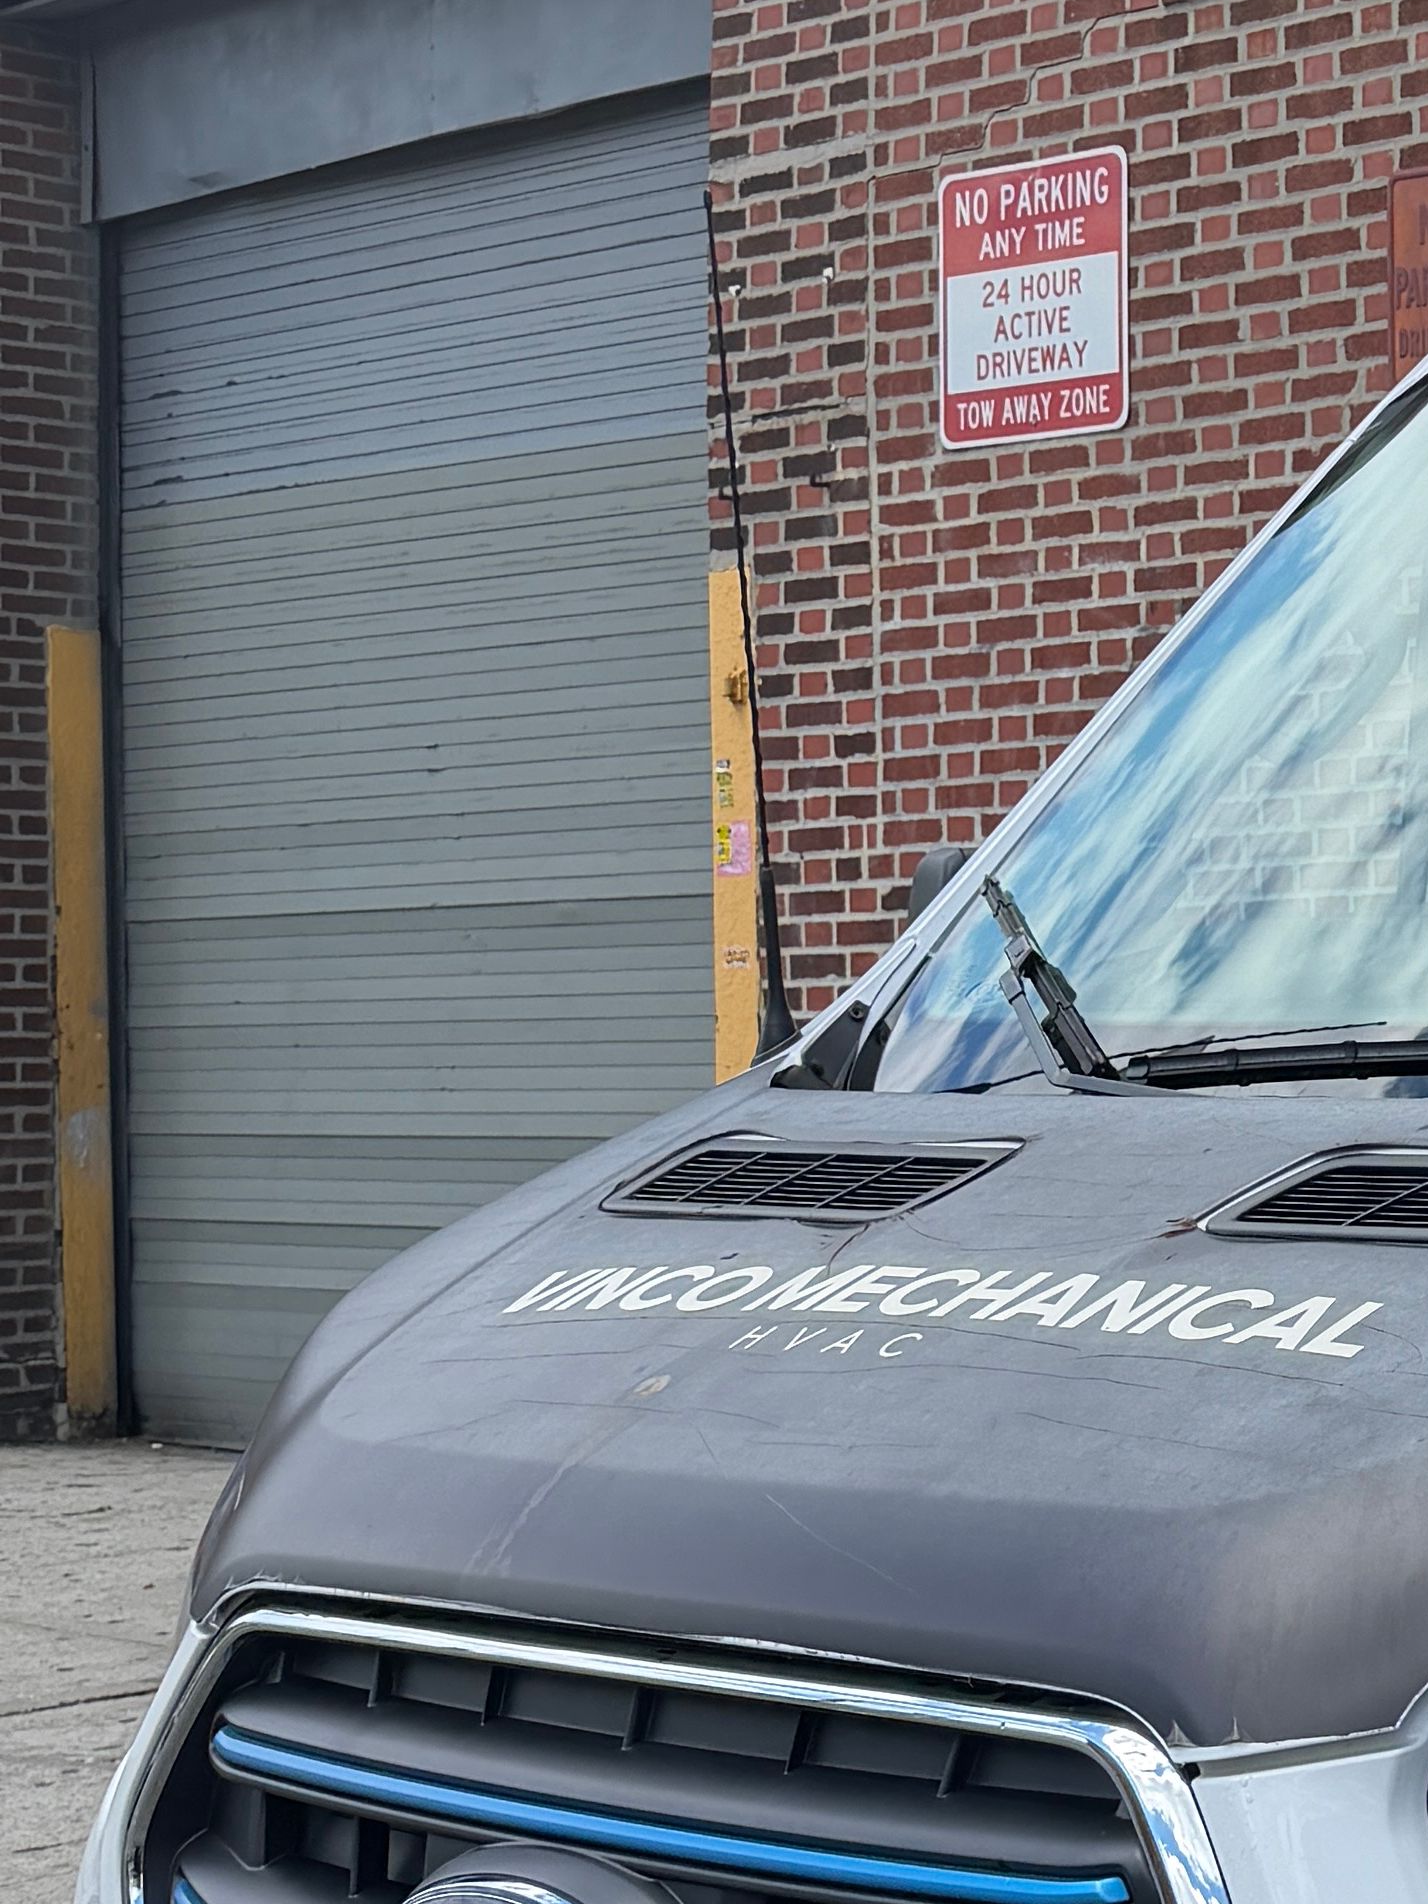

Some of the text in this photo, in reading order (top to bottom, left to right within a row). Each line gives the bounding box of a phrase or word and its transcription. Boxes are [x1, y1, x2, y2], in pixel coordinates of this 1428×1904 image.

[954, 167, 1109, 228] NO PARKING
[979, 218, 1086, 262] ANY TIME
[982, 268, 1082, 308] 24 HOUR
[994, 310, 1072, 344] ACTIVE
[976, 340, 1089, 381] DRIVEWAY
[956, 384, 1110, 431] TOW AWAY ZONE
[502, 1264, 1386, 1359] VINCO MECHANICAL
[728, 1326, 925, 1358] HVAC
